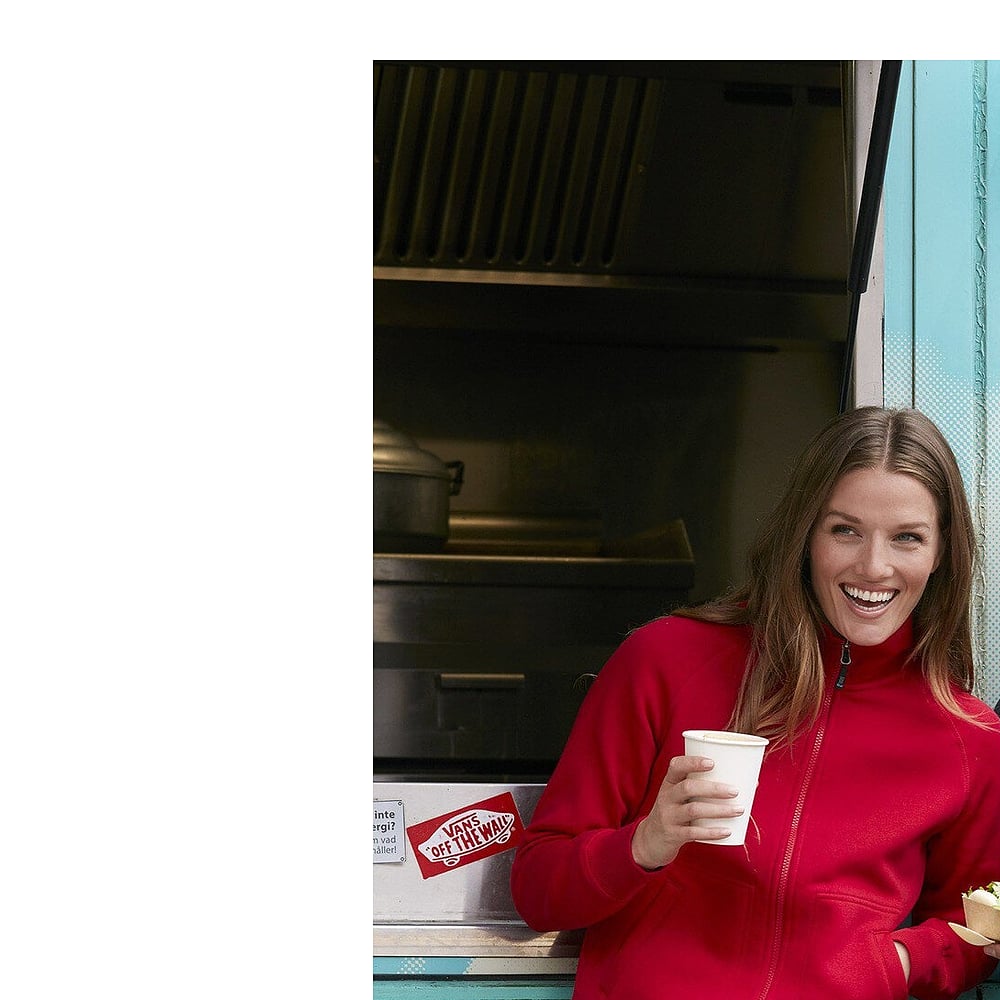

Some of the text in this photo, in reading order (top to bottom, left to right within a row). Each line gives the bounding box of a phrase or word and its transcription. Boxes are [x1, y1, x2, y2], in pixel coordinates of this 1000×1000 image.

[374, 810, 396, 819] inte
[442, 813, 481, 838] VANS
[380, 835, 397, 844] vad
[452, 829, 483, 851] THE
